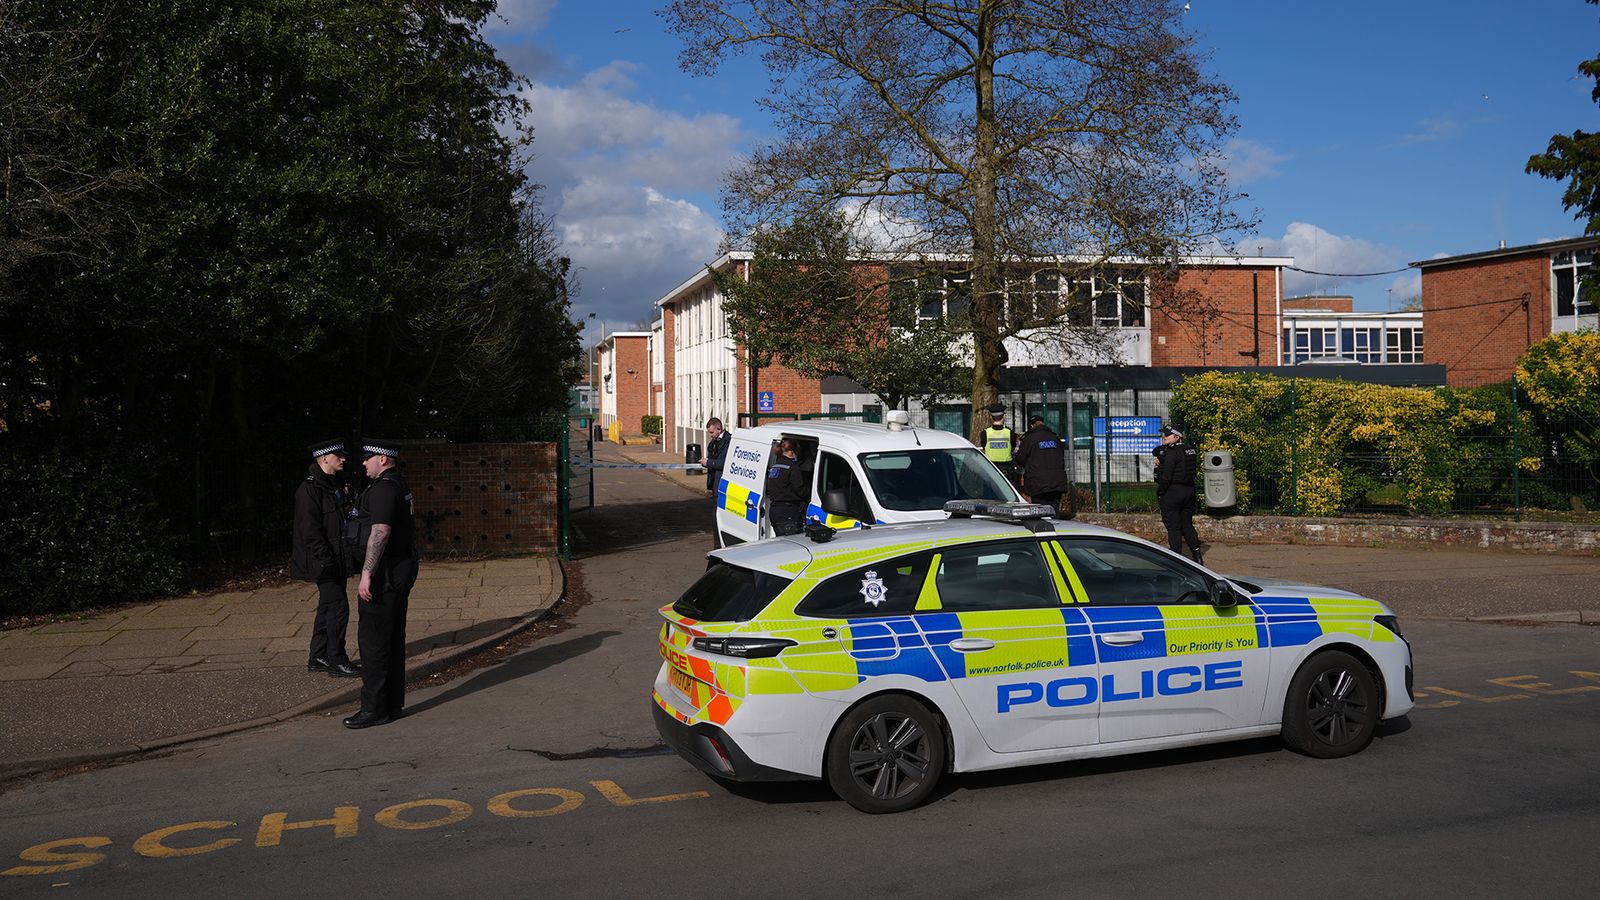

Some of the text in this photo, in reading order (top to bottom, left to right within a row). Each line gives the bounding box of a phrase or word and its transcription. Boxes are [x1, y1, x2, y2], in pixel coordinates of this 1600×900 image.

[1107, 420, 1147, 428] eception
[733, 446, 761, 463] Forensic
[729, 462, 757, 480] Services
[1169, 638, 1254, 653] Our Priority is You
[659, 642, 688, 671] OLICE
[969, 658, 1064, 675] www.norfolk.police.uk
[997, 660, 1244, 714] POLICE
[1, 780, 710, 876] SCHOOL
